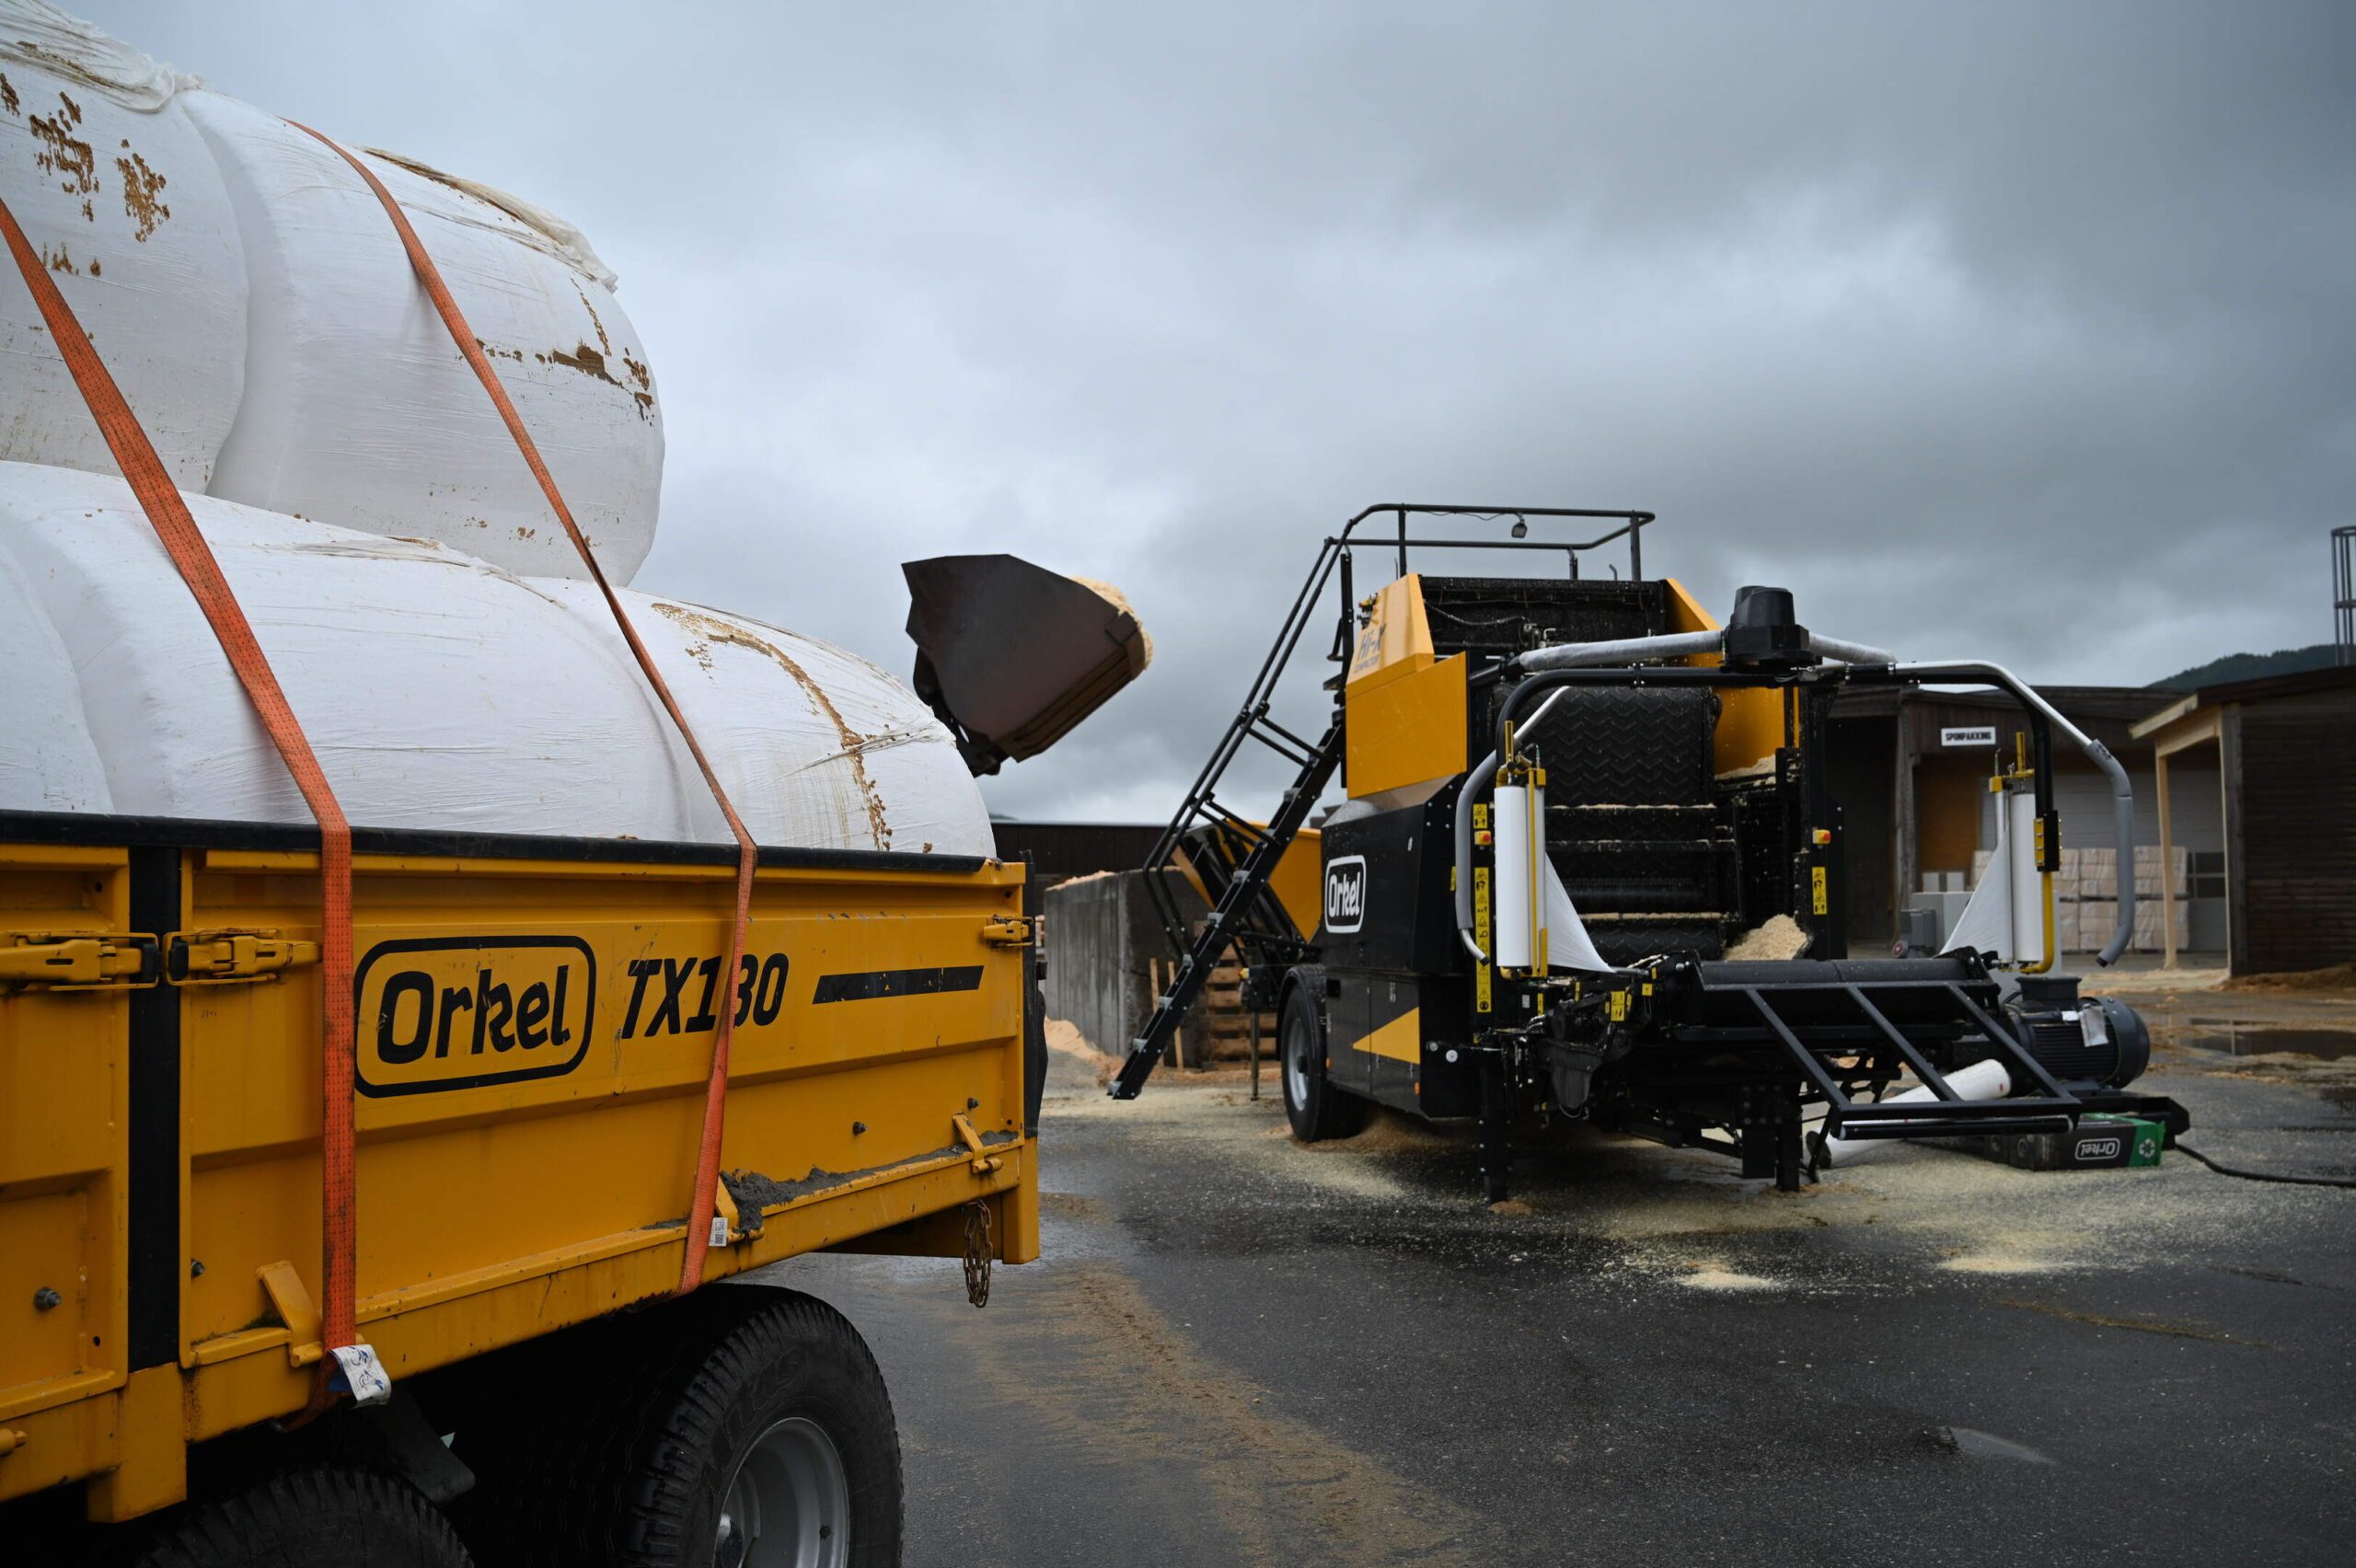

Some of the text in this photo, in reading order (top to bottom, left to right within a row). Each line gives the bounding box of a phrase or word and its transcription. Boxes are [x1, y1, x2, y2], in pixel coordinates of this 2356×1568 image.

[1946, 732, 1992, 741] SPONPAKKING
[1328, 871, 1360, 917] Orkel
[377, 952, 790, 1065] Orkel TX130
[2081, 1141, 2117, 1157] Orkel
